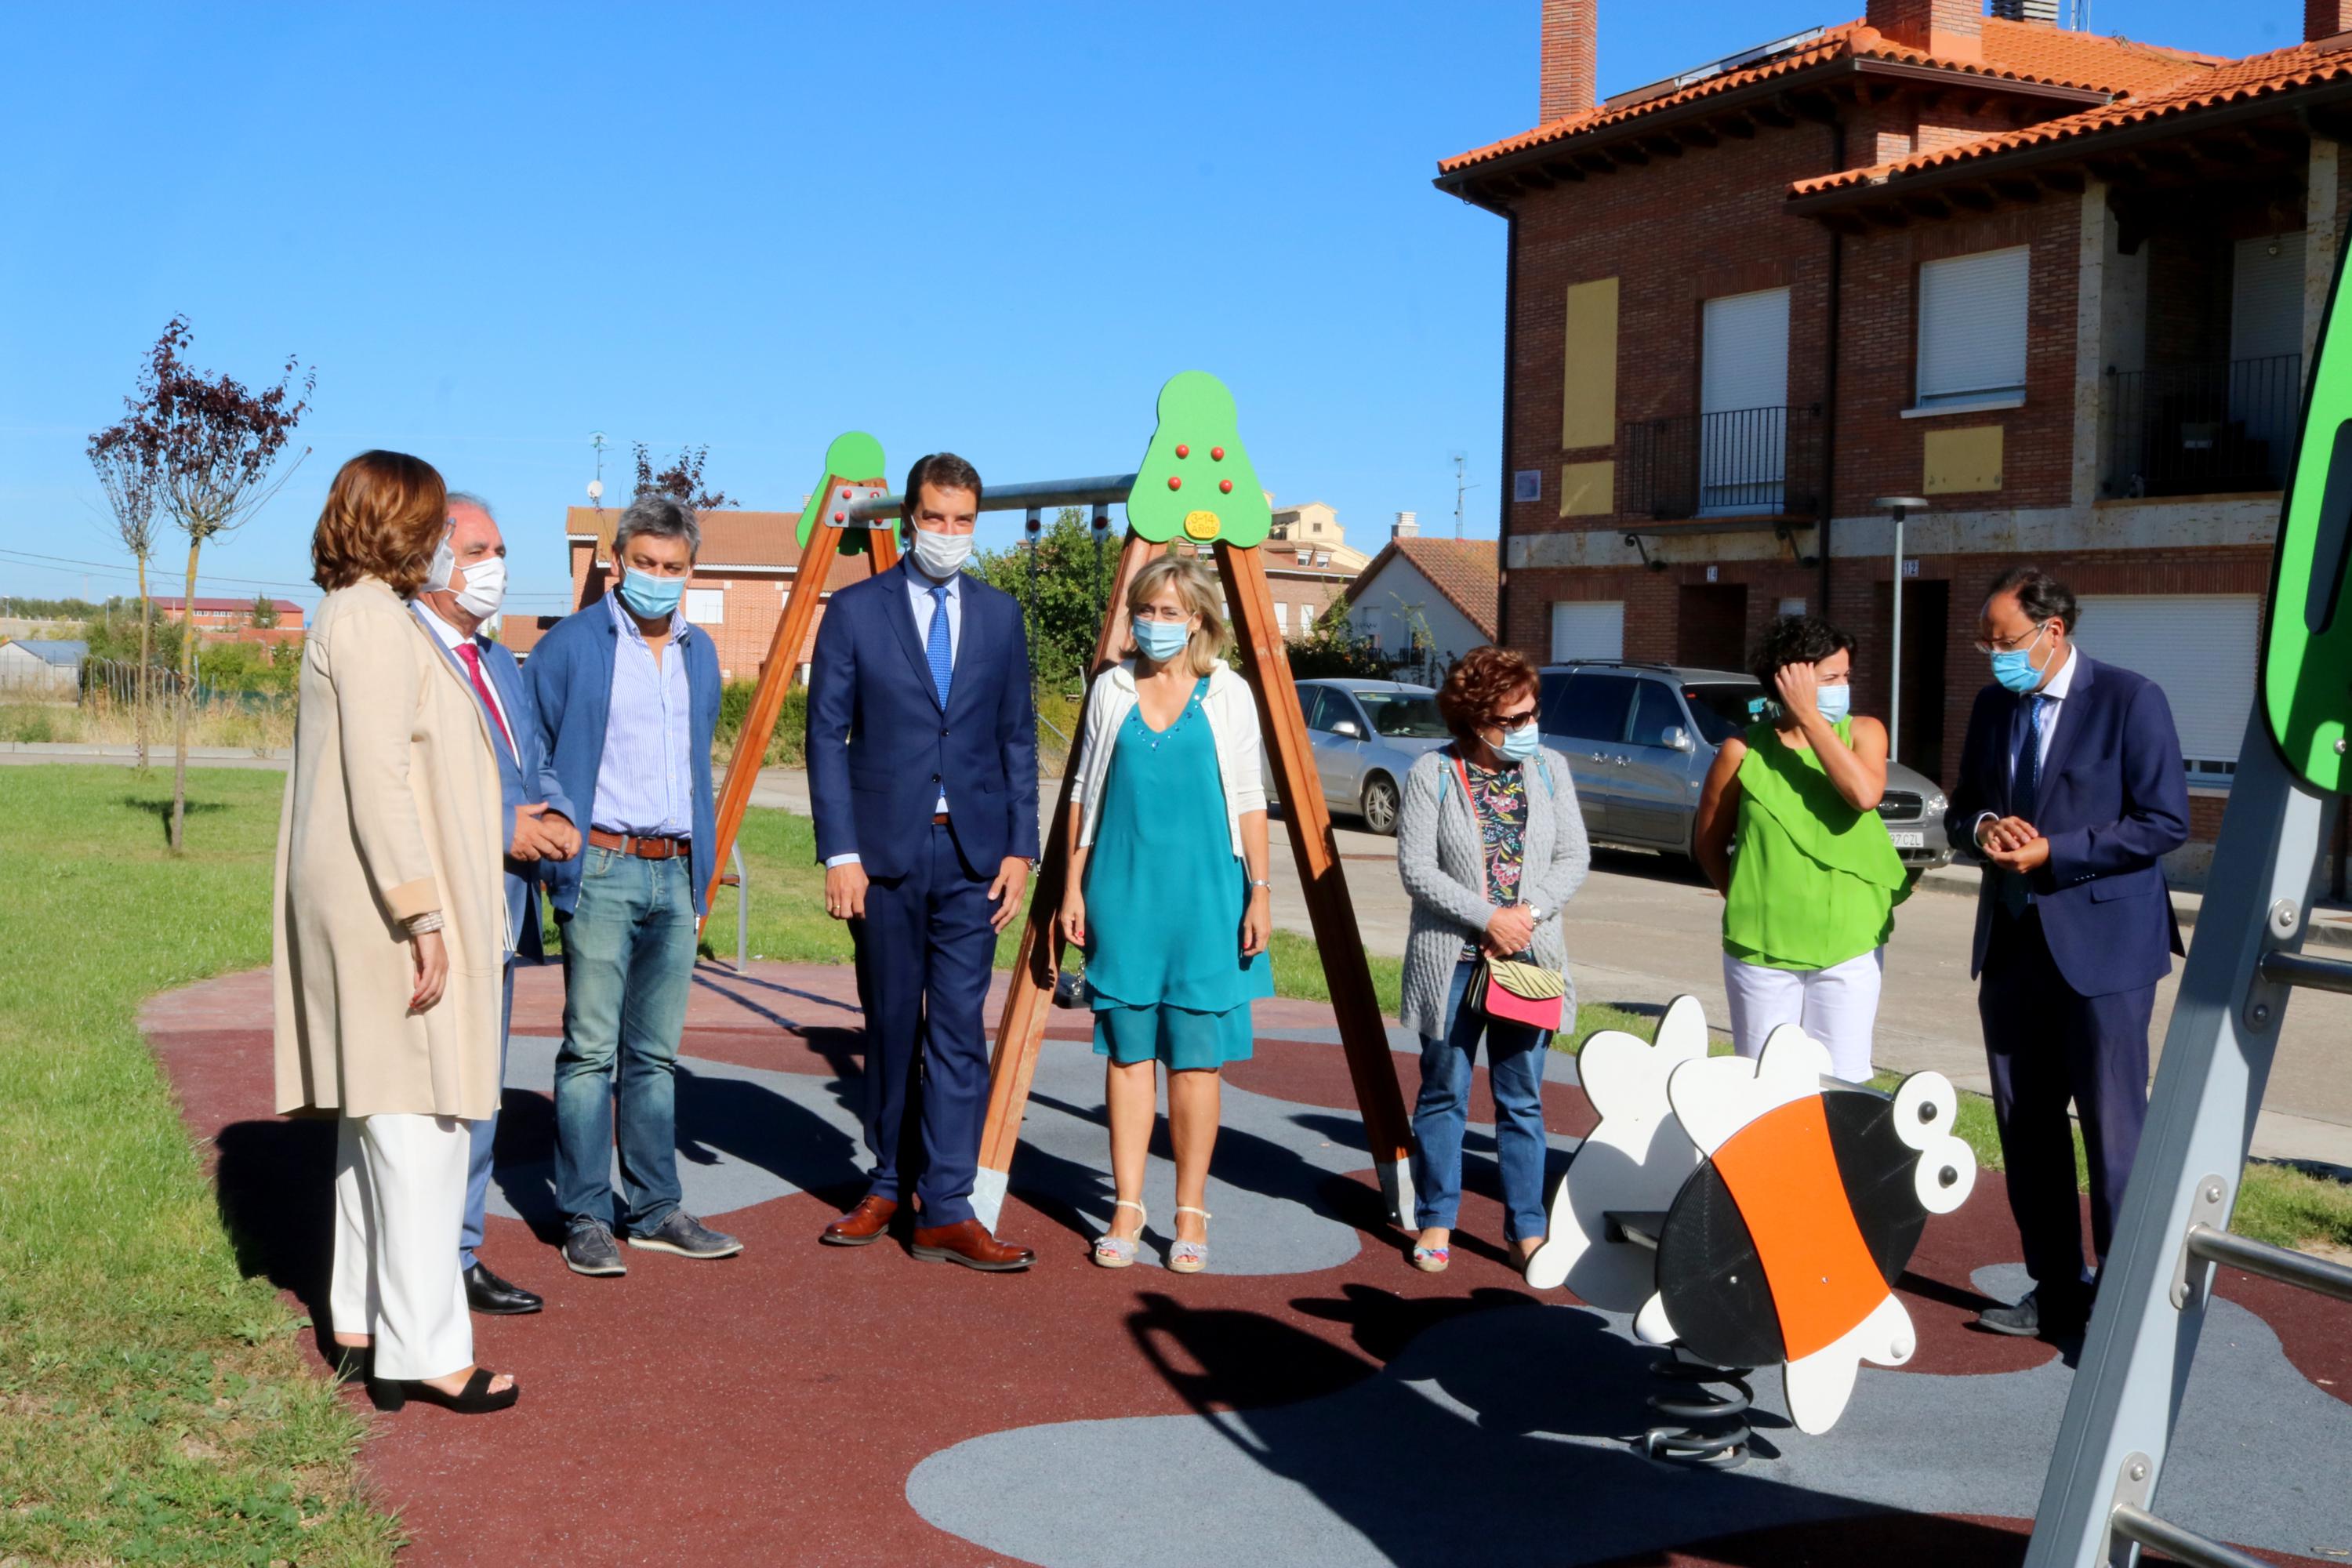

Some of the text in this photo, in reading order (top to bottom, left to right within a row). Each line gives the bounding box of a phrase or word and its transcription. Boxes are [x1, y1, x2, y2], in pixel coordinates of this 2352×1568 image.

[1191, 513, 1215, 524] 3-14
[1192, 524, 1217, 534] AÑOS
[1906, 561, 1916, 574] 12
